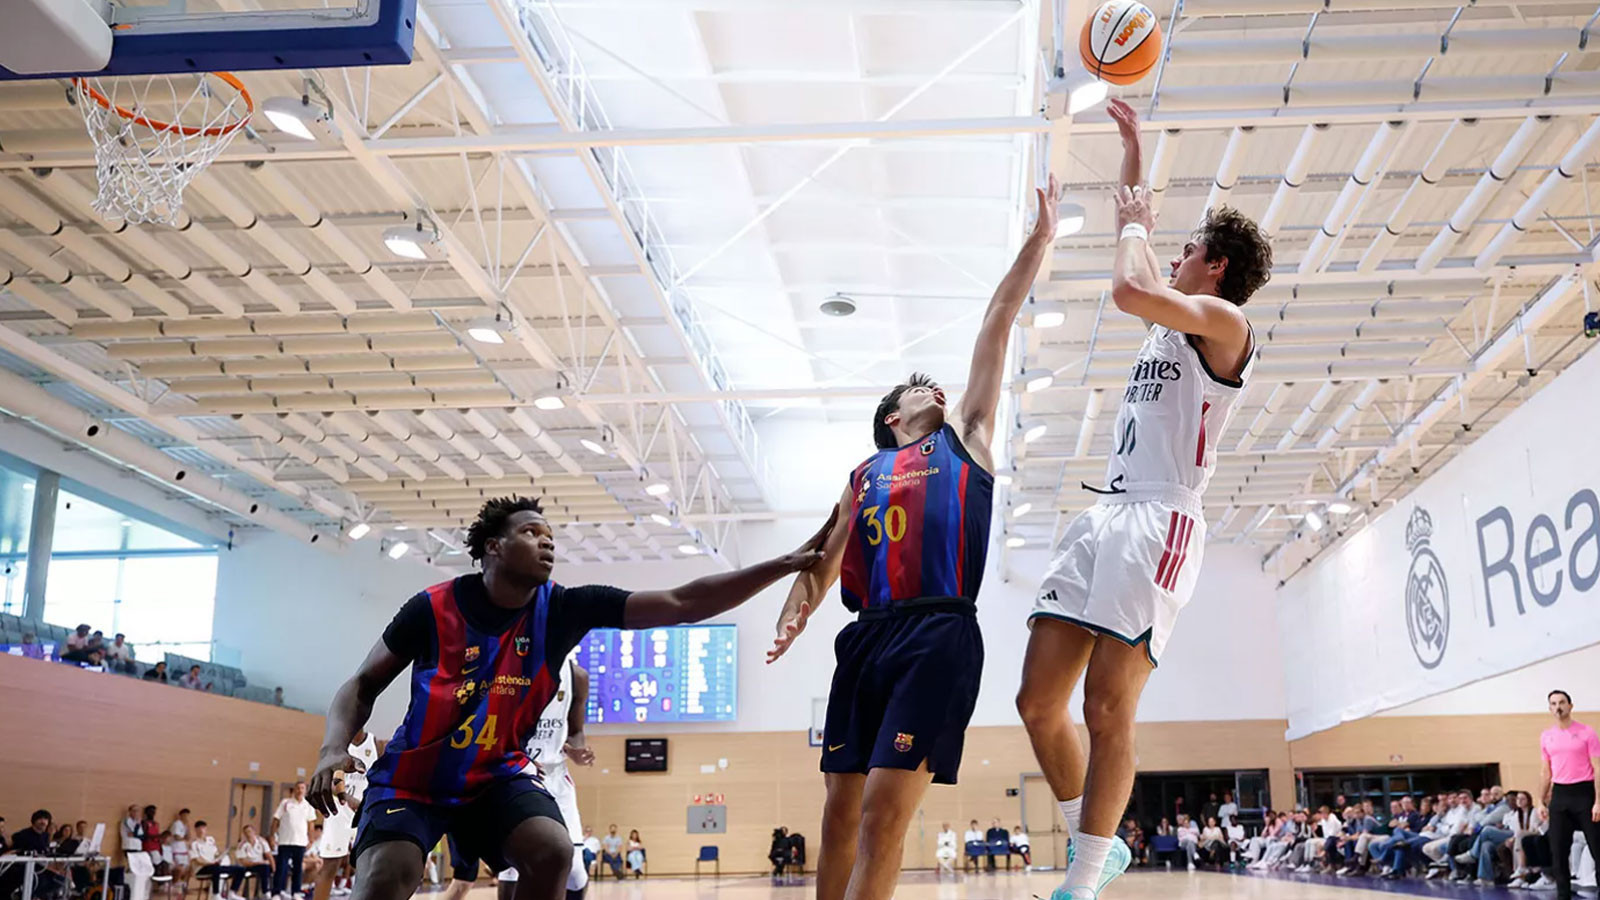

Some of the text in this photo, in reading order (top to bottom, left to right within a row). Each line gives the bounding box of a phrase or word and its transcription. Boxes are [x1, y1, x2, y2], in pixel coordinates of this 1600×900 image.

[862, 504, 907, 546] 30
[1475, 488, 1600, 628] Rea
[450, 714, 499, 751] 34
